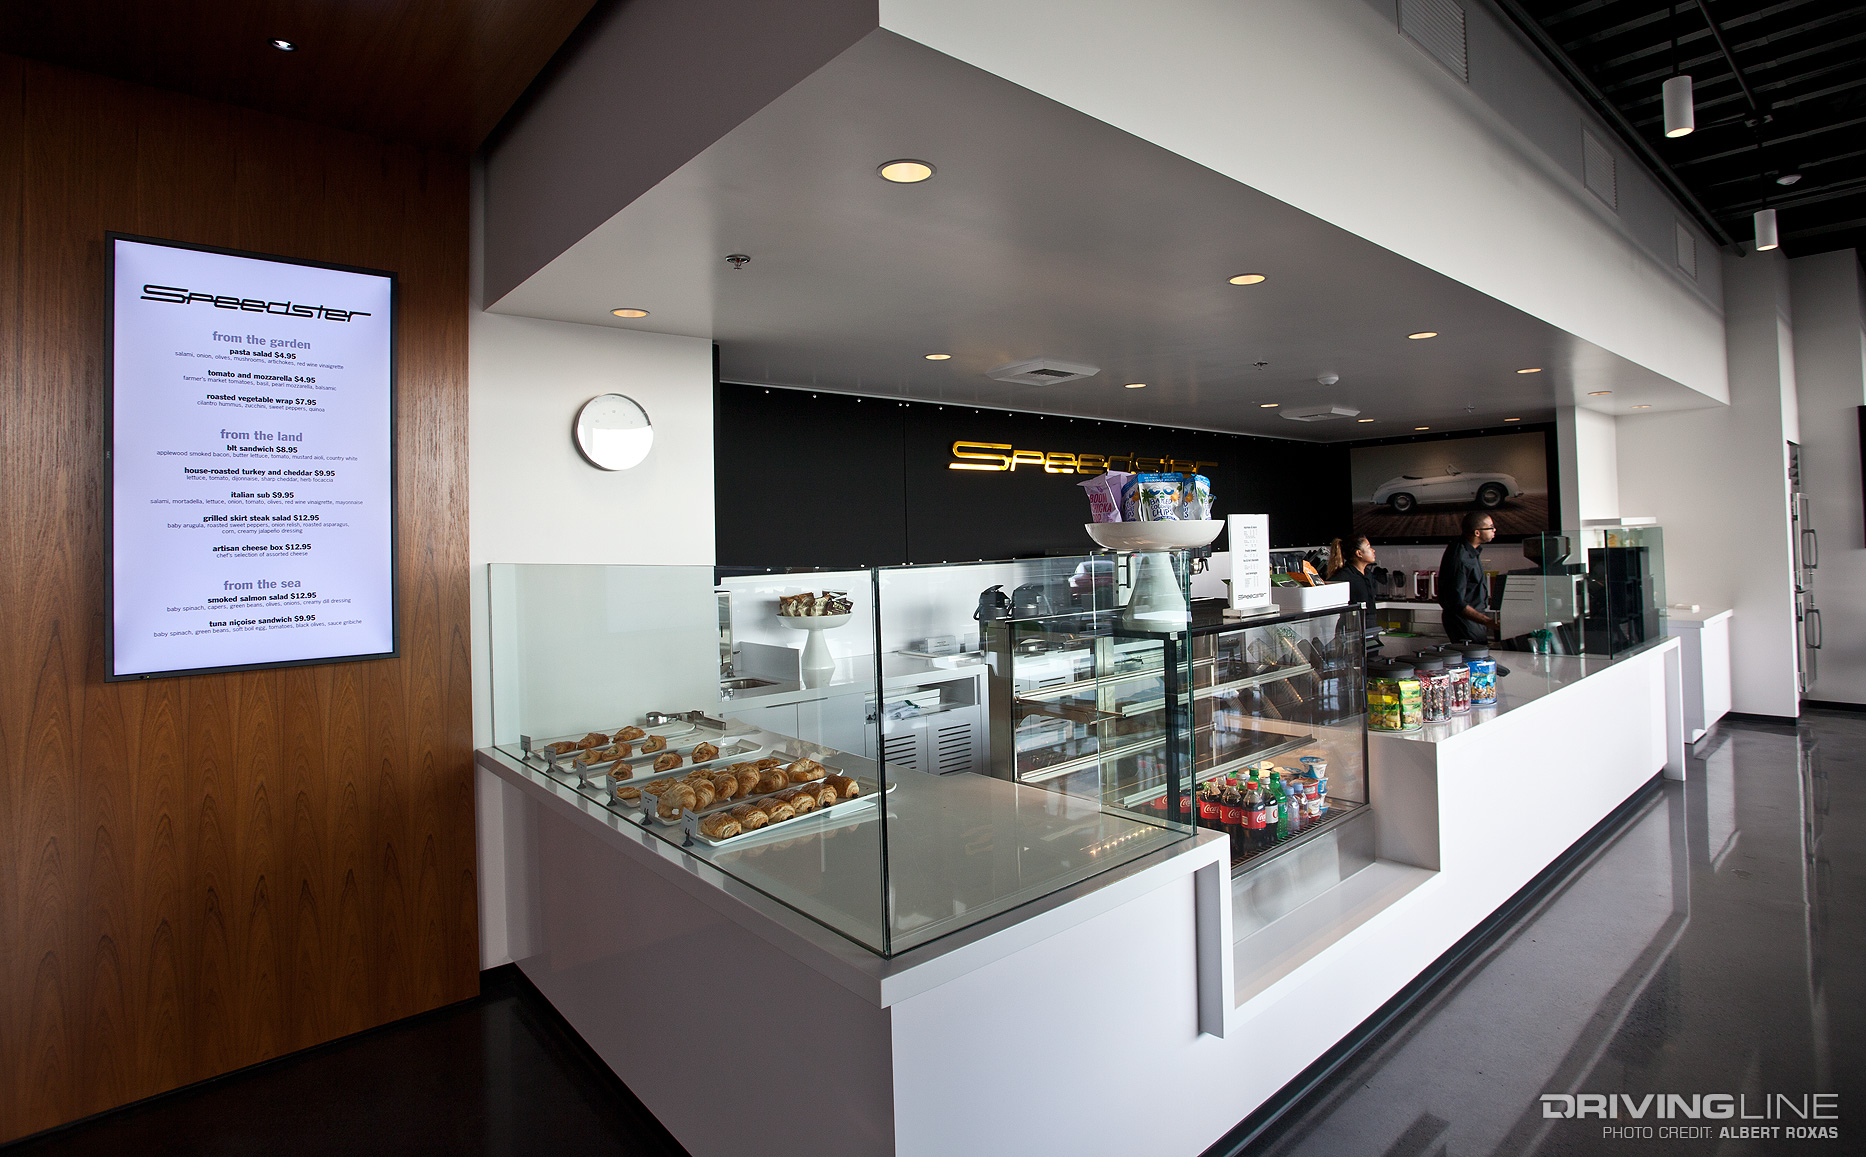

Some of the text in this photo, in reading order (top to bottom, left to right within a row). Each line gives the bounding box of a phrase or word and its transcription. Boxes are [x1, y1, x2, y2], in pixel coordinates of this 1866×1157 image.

[212, 331, 310, 349] from the garden
[220, 429, 303, 442] from the land
[949, 440, 1219, 474] Speedster
[223, 580, 253, 590] from
[257, 579, 277, 589] the
[229, 619, 256, 627] niçoise
